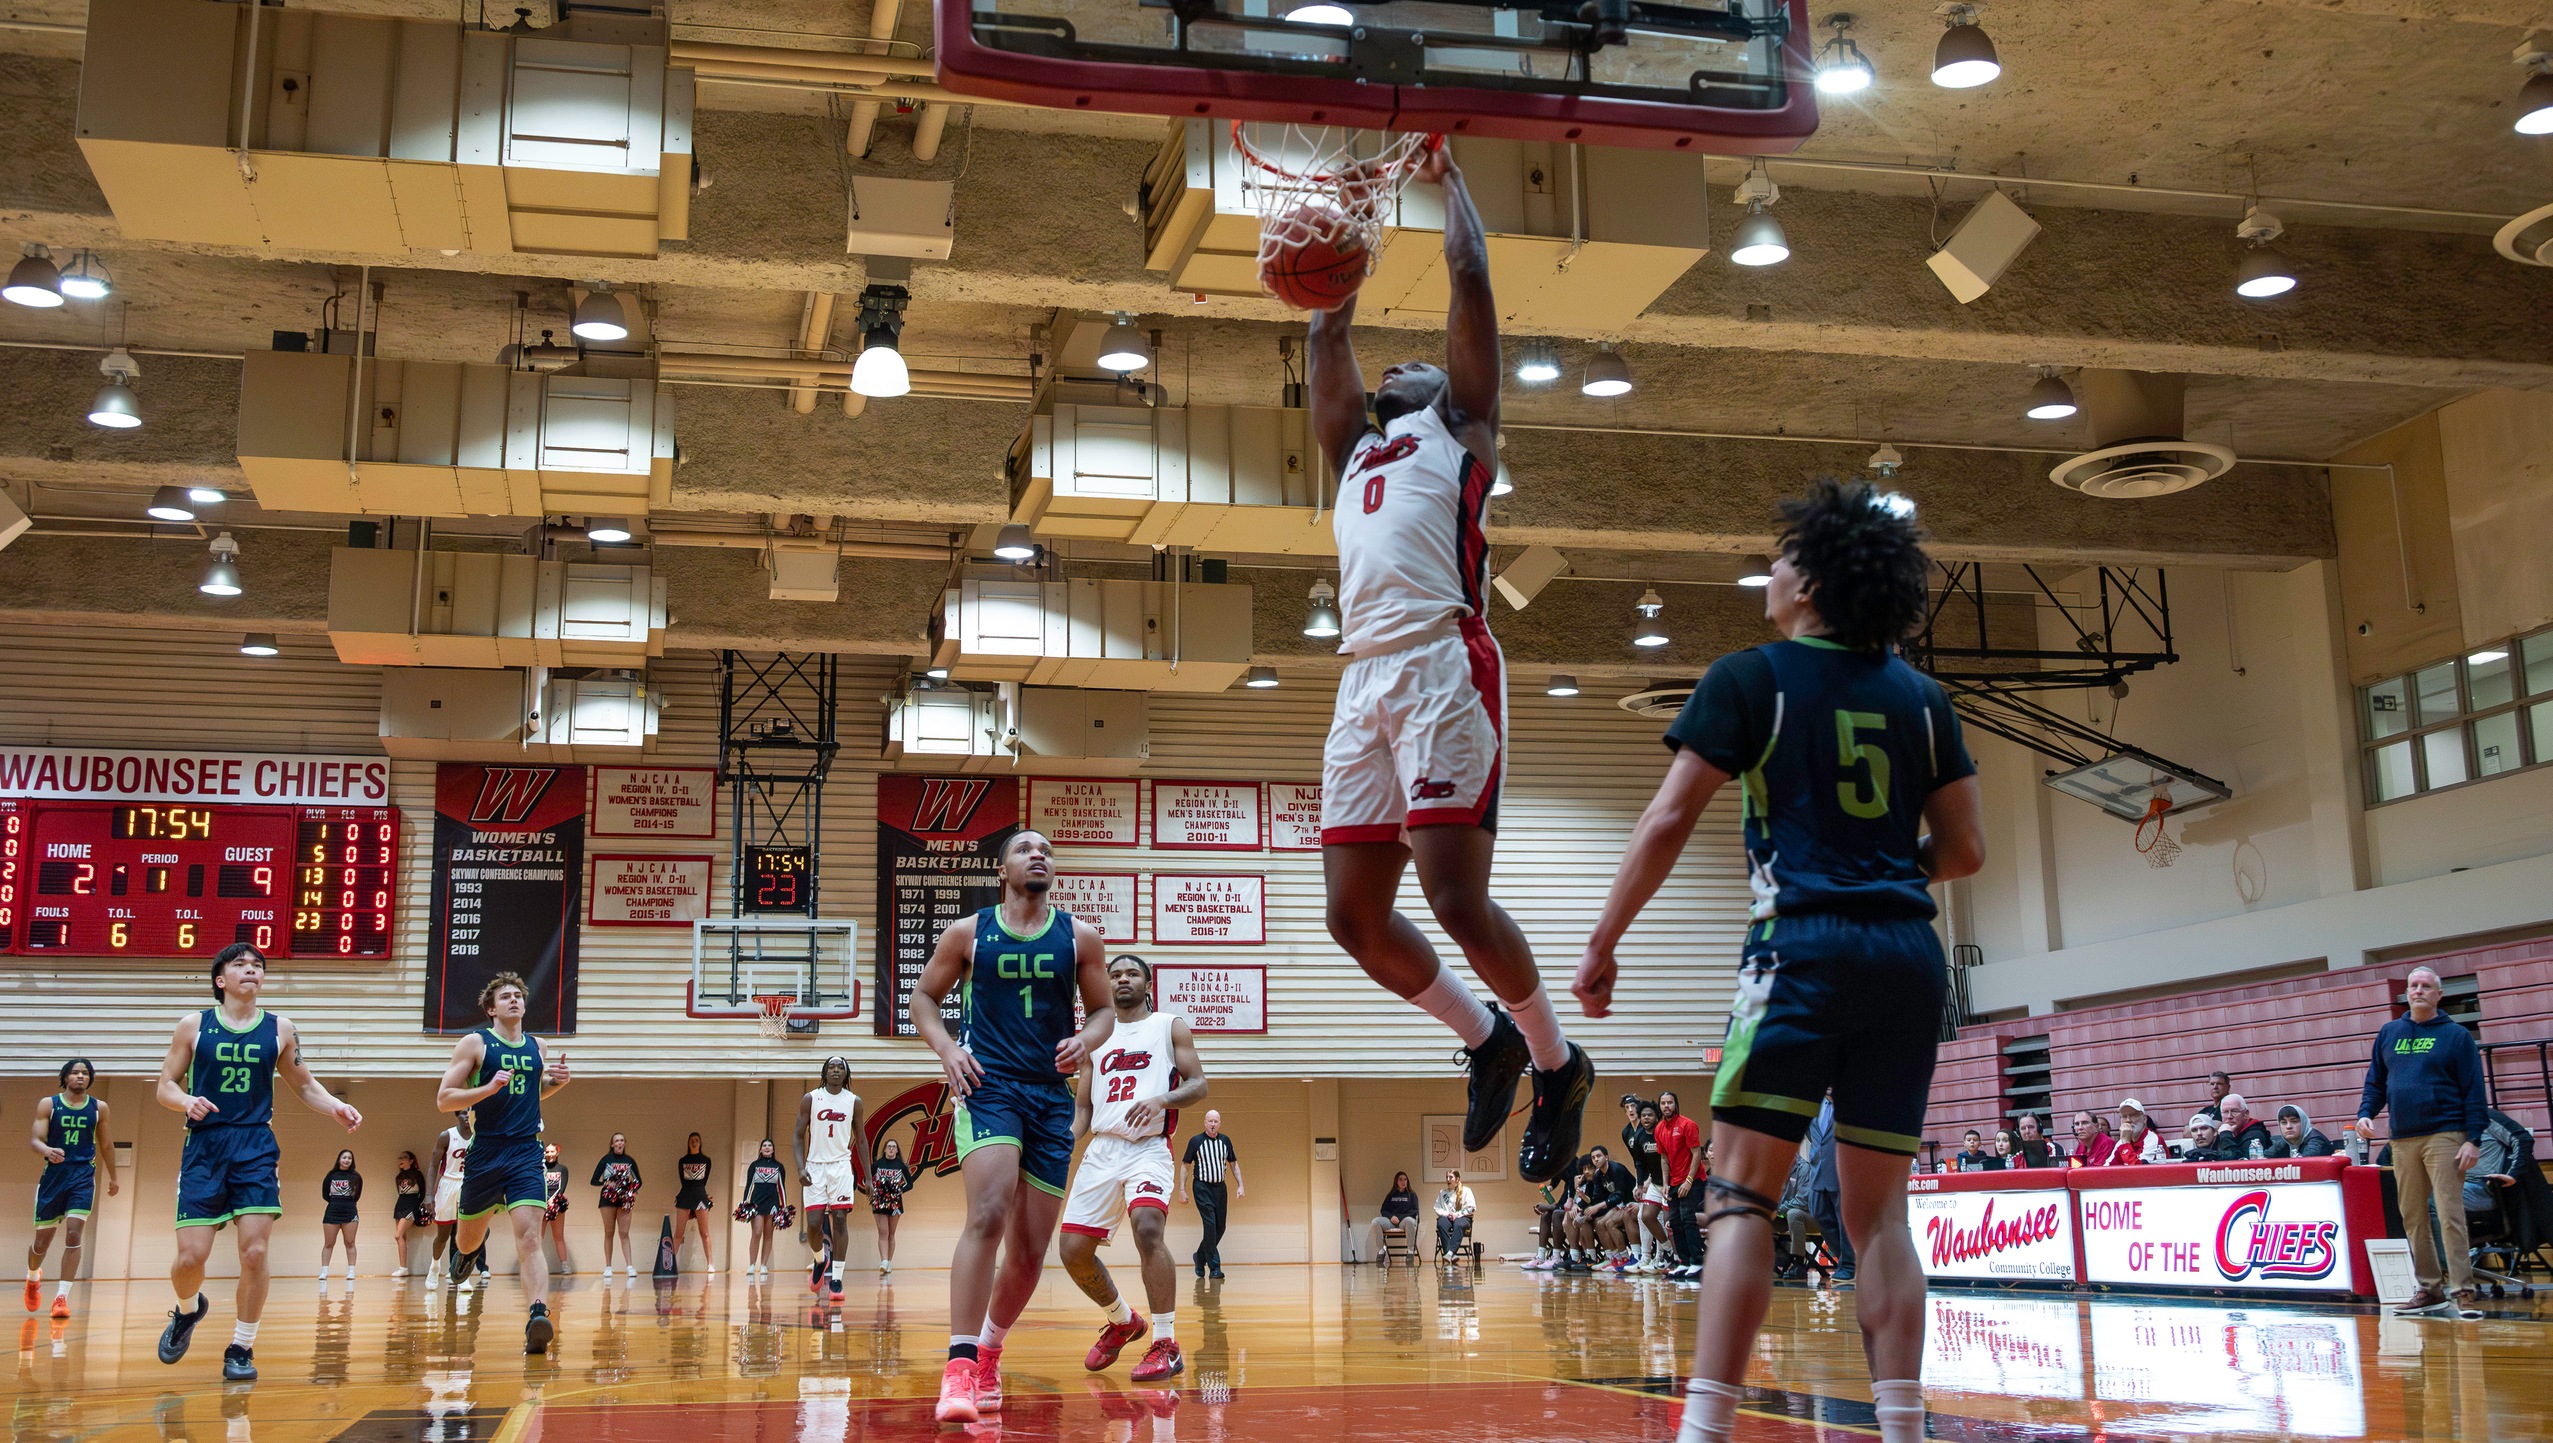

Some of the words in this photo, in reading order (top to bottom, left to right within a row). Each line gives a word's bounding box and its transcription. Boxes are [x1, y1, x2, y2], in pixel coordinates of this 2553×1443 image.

[1363, 474, 1386, 515] 0
[1834, 709, 1890, 819] 5
[0, 753, 241, 795] WAUBONSEE
[254, 760, 386, 799] CHIEFS
[470, 766, 559, 823] W
[621, 784, 651, 794] REGION
[608, 795, 647, 805] WOMEN'S
[649, 797, 701, 807] BASKETBALL
[911, 777, 993, 832] W
[1051, 796, 1080, 806] REGION
[1175, 799, 1205, 808] REGION
[306, 808, 326, 819] PLYR
[341, 809, 355, 820] FLS
[373, 810, 388, 820] PTS
[630, 807, 678, 817] CHAMPIONS
[1043, 807, 1067, 817] MEN'S
[1072, 808, 1122, 819] BASKETBALL
[1167, 809, 1193, 818] MEN'S
[1196, 810, 1246, 819] BASKETBALL
[1275, 812, 1304, 822] MEN'S
[7, 816, 20, 834] 0
[128, 808, 211, 839] 17:54
[633, 819, 675, 829] 2014-15
[1061, 819, 1105, 829] CHAMPIONS
[1184, 821, 1230, 830] CHAMPIONS
[1292, 825, 1309, 834] 7TH
[321, 824, 327, 839] 1
[347, 824, 359, 841] 0
[379, 824, 391, 841] 0
[471, 831, 557, 845] WOMEN'S
[1052, 829, 1113, 839] 1999-2000
[1187, 832, 1228, 842] 2010-11
[5, 839, 18, 857] 0
[47, 843, 92, 859] HOME
[925, 840, 979, 852] MEN'S
[141, 853, 179, 864] PERIOD
[225, 846, 274, 862] GUEST
[313, 845, 325, 863] 5
[345, 846, 357, 863] 0
[380, 846, 390, 864] 3
[451, 849, 565, 863] BASKETBALL
[757, 854, 805, 872] 17:54
[895, 856, 1000, 869] BASKETBALL
[3, 862, 16, 879] 2
[305, 867, 324, 885] 13
[344, 868, 356, 885] 0
[383, 870, 388, 885] 1
[451, 868, 480, 880] SKYWAY
[480, 868, 523, 880] CONFERENCE
[523, 869, 564, 881] CHAMPIONS
[73, 864, 94, 895] 2
[159, 869, 167, 891] 1
[254, 867, 273, 896] 9
[617, 874, 648, 884] REGION
[895, 874, 922, 886] SKYWAY
[923, 875, 963, 887] CONFERENCE
[963, 875, 1001, 887] CHAMPIONS
[1, 885, 14, 902] 0
[454, 883, 483, 893] 1993
[604, 886, 643, 895] WOMEN'S
[645, 886, 698, 896] BASKETBALL
[757, 874, 796, 906] 23
[900, 889, 924, 900] 1971
[934, 889, 960, 900] 1999
[304, 891, 322, 906] 14
[342, 890, 355, 908] 0
[375, 891, 387, 908] 0
[626, 898, 675, 907] CHAMPIONS
[1049, 892, 1077, 901] REGION
[1177, 892, 1206, 902] REGION
[453, 898, 482, 909] 2014
[899, 904, 925, 915] 1974
[934, 904, 960, 915] 2001
[1071, 903, 1119, 913] BASKETBALL
[1165, 904, 1194, 913] MEN'S
[1196, 904, 1252, 914] BASKETBALL
[35, 906, 69, 917] FOULS
[107, 908, 136, 919] T.O.L.
[175, 909, 203, 920] T.O.L.
[241, 909, 274, 920] FOULS
[629, 909, 671, 919] 2015-16
[295, 912, 321, 930] 23
[341, 913, 353, 931] 0
[375, 913, 386, 931] 3
[452, 913, 481, 924] 2016
[899, 919, 925, 929] 1977
[1186, 915, 1232, 924] CHAMPIONS
[60, 924, 67, 945] 1
[111, 923, 127, 947] 6
[178, 924, 195, 948] 6
[256, 925, 272, 949] 0
[451, 929, 480, 940] 2017
[1190, 927, 1229, 936] 2016-17
[339, 935, 351, 953] 0
[898, 933, 925, 944] 1978
[451, 944, 480, 955] 2018
[898, 948, 925, 959] 1982
[898, 963, 925, 974] 1990
[997, 953, 1054, 979] CLC
[1178, 982, 1212, 992] REGION
[1018, 985, 1033, 1018] 1
[1169, 994, 1196, 1003] MEN'S
[1200, 994, 1250, 1003] BASKETBALL
[1187, 1005, 1233, 1014] CHAMPIONS
[1195, 1016, 1226, 1026] 2022-23
[215, 1042, 261, 1063] CLC
[500, 1053, 534, 1071] CLC
[219, 1066, 251, 1093] 23
[509, 1073, 526, 1095] 13
[1106, 1075, 1137, 1103] 22
[61, 1115, 88, 1129] CLC
[827, 1123, 834, 1138] 1
[64, 1129, 80, 1146] 14
[2197, 1164, 2301, 1184] Waubonsee.edu
[1915, 1198, 1947, 1209] Welcome
[1949, 1199, 1957, 1209] to
[2085, 1200, 2143, 1230] HOME
[1927, 1197, 2060, 1268] Waubonsee
[2213, 1188, 2339, 1282] CHIEFS
[2128, 1242, 2155, 1272] OF
[2160, 1242, 2200, 1272] THE
[1989, 1261, 2037, 1277] Community
[2039, 1262, 2071, 1278] College
